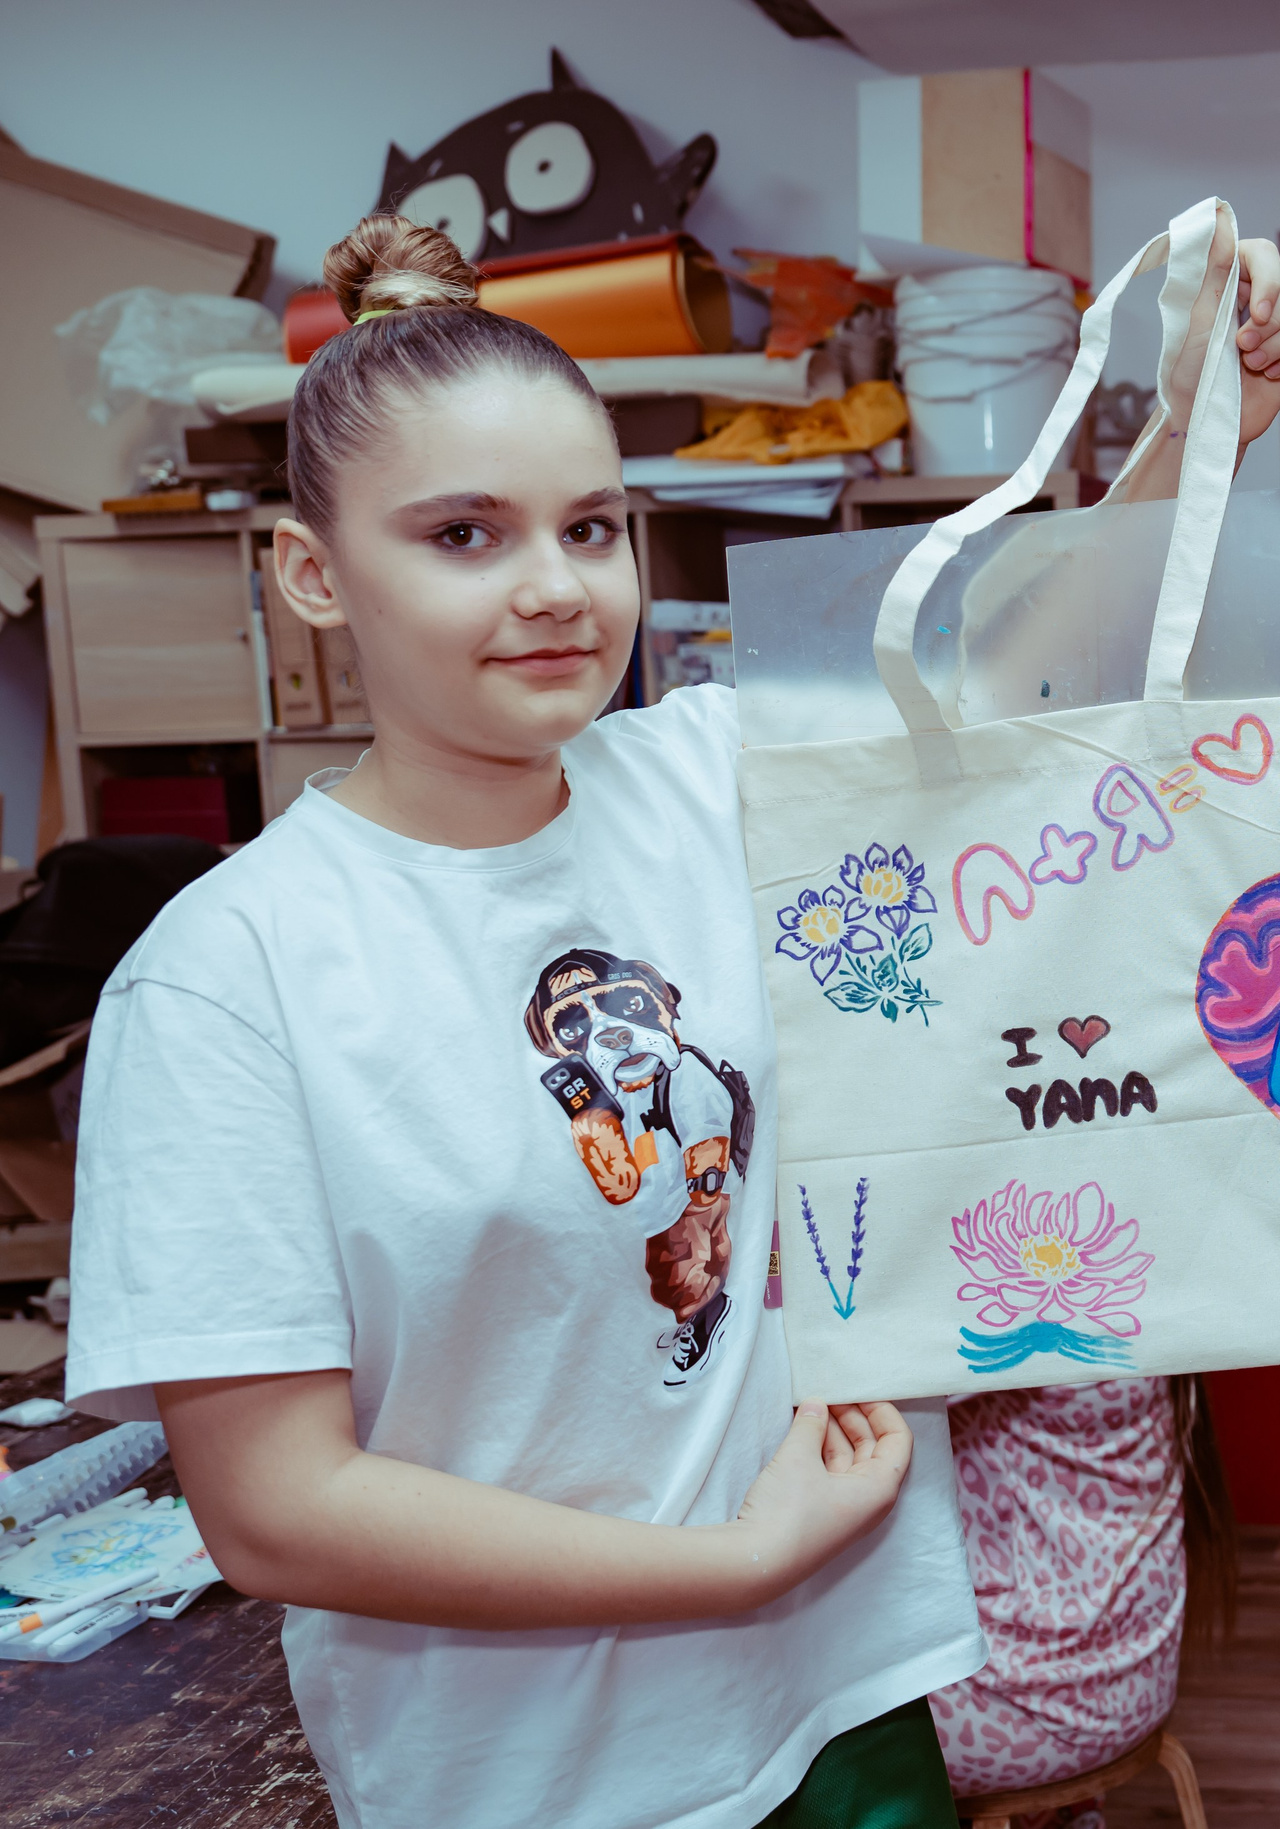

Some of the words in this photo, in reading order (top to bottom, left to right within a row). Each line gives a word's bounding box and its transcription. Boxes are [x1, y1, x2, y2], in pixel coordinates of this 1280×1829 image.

[1001, 1027, 1043, 1068] I
[563, 1078, 587, 1099] GR
[570, 1087, 591, 1109] ST
